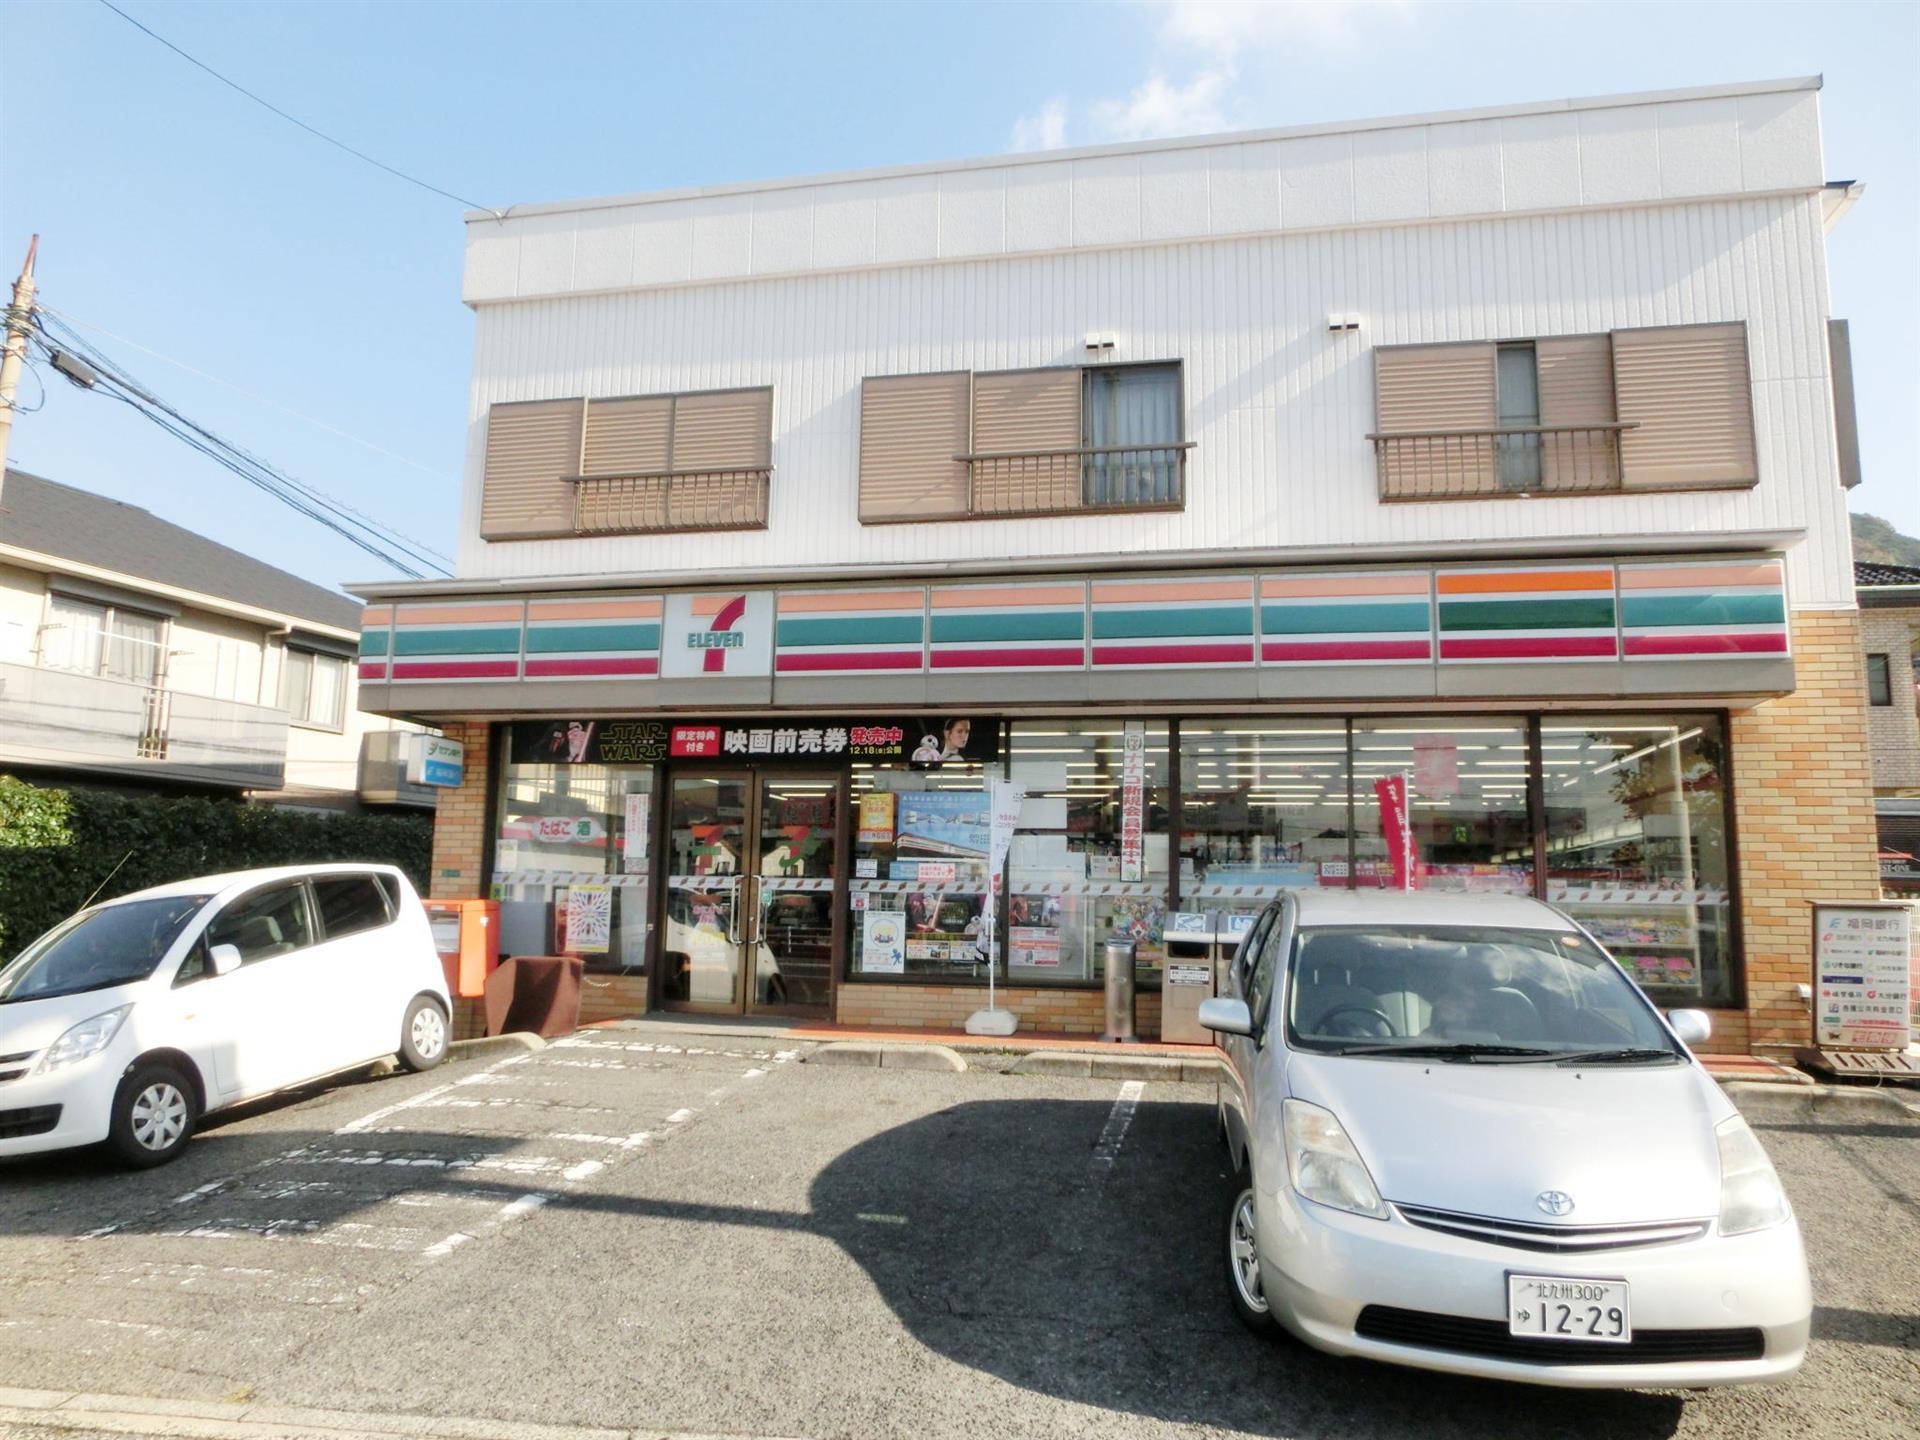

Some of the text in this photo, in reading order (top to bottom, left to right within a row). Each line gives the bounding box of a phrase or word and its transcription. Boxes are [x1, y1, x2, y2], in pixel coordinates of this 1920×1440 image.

[687, 631, 744, 648] ELEVEN
[600, 723, 667, 739] STAR
[676, 730, 715, 741] 限定特典
[850, 726, 902, 745] 発売中
[686, 743, 705, 752] 付き
[724, 728, 848, 754] 映画前売券
[600, 744, 666, 760] WARS
[539, 821, 591, 836] たばこ 酒
[1847, 918, 1900, 930] 福岡銀行
[1537, 1282, 1604, 1301] 北九州300
[1541, 1302, 1623, 1336] 12-29
